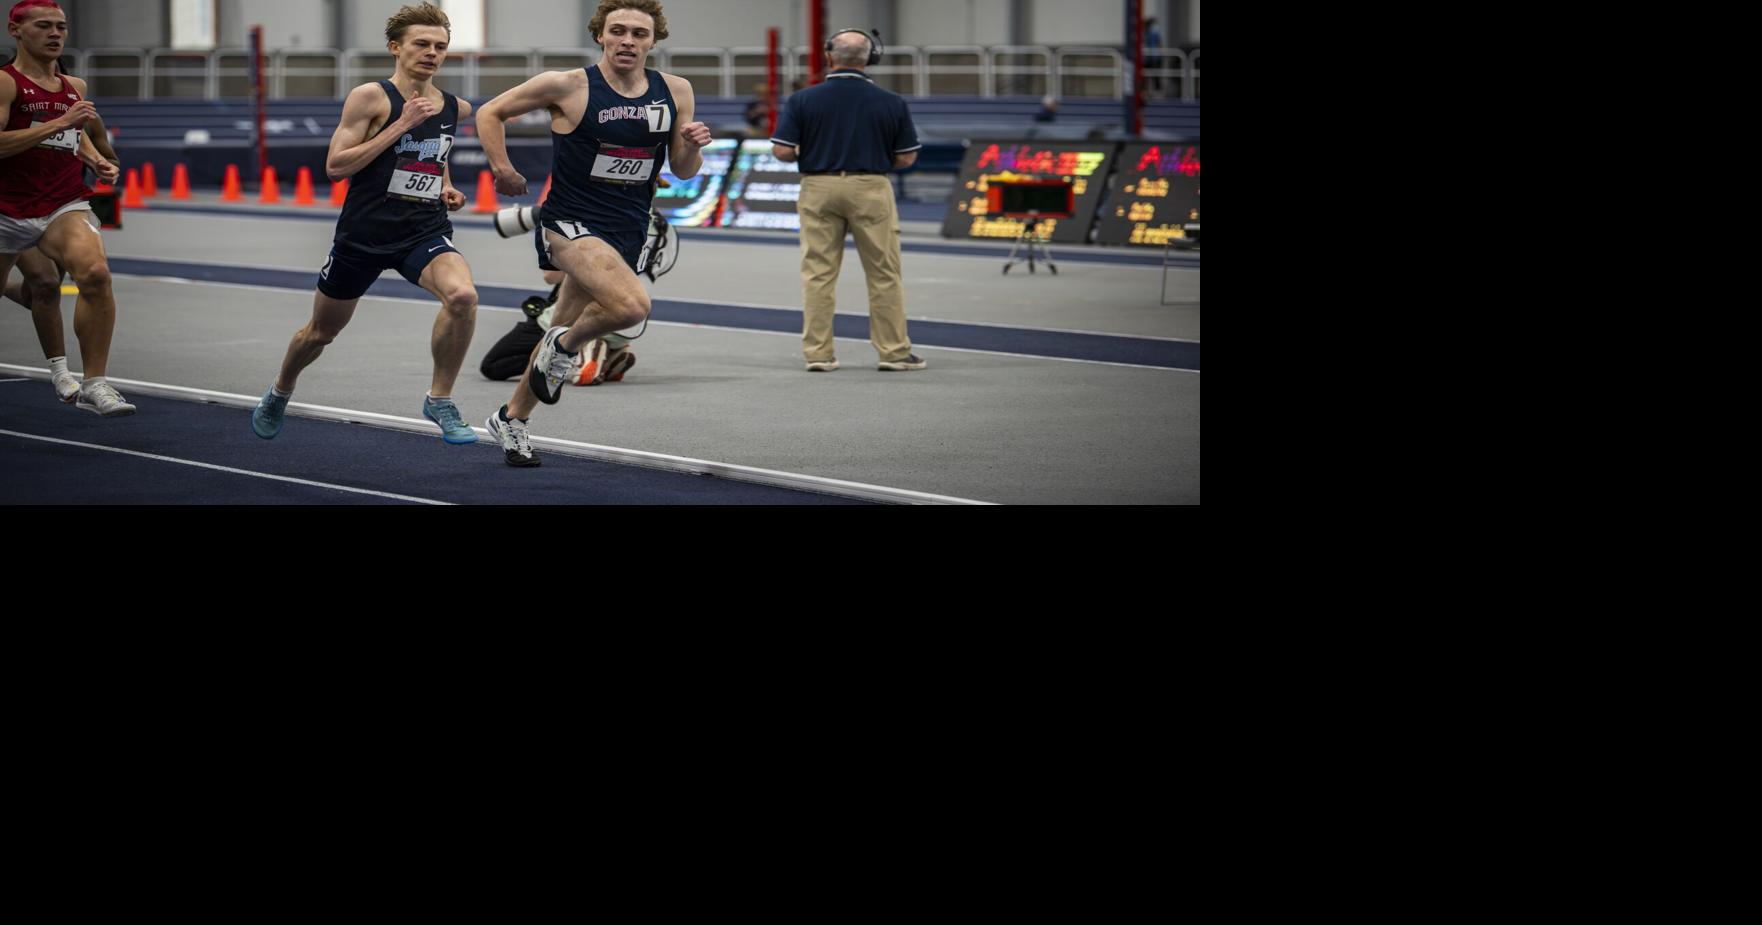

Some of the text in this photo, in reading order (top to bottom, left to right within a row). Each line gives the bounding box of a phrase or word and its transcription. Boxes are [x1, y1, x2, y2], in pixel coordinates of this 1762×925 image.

[21, 102, 73, 112] SAINT MA
[650, 106, 665, 131] 7
[440, 137, 453, 161] 2
[606, 159, 643, 175] 260
[405, 174, 437, 192] 567
